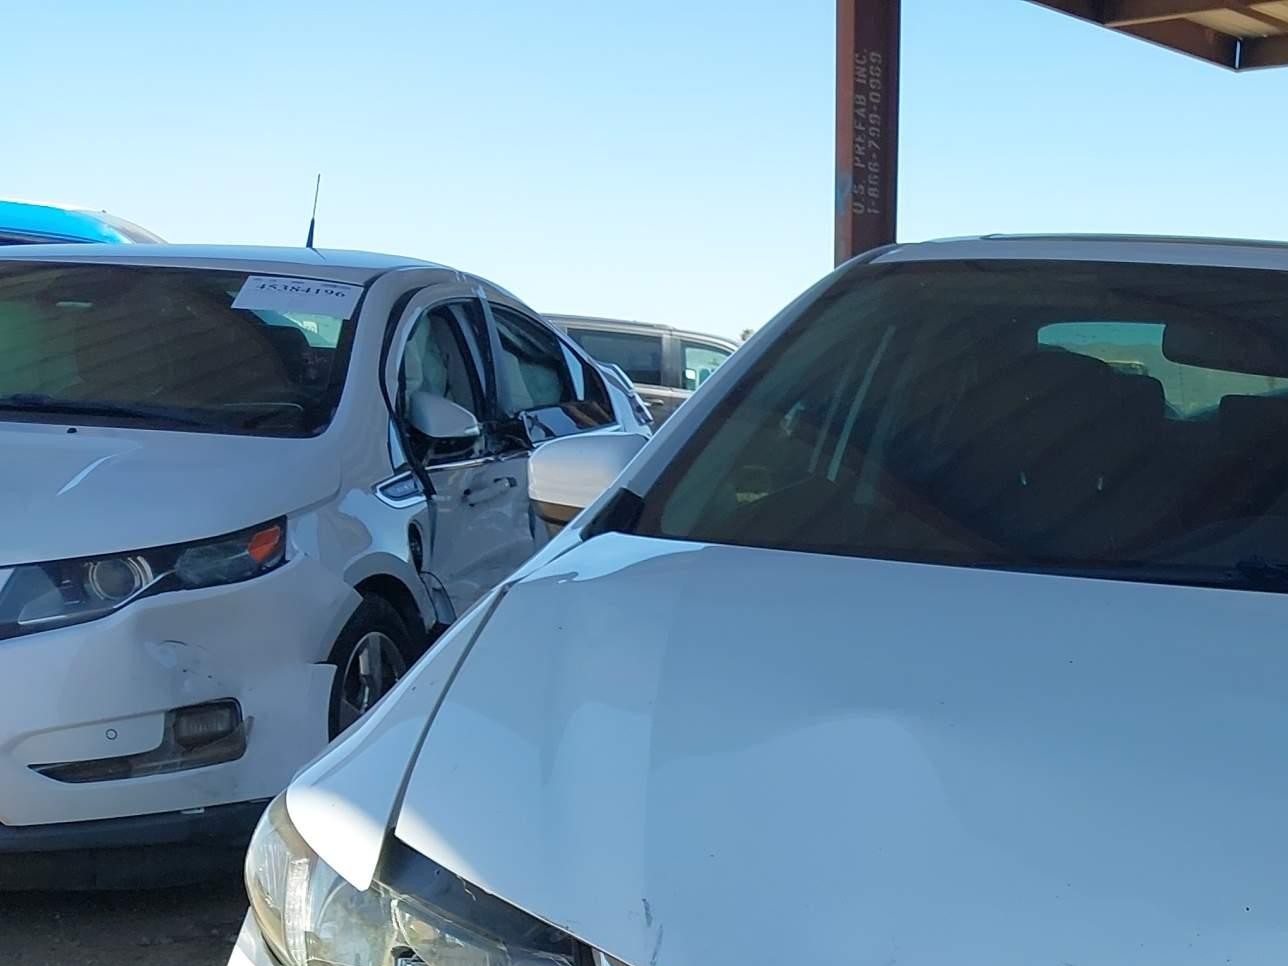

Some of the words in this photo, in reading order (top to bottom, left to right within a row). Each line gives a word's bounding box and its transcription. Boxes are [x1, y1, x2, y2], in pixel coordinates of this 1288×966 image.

[855, 48, 868, 84] INC.
[854, 94, 867, 168] PREFAB
[852, 179, 866, 214] U.S.
